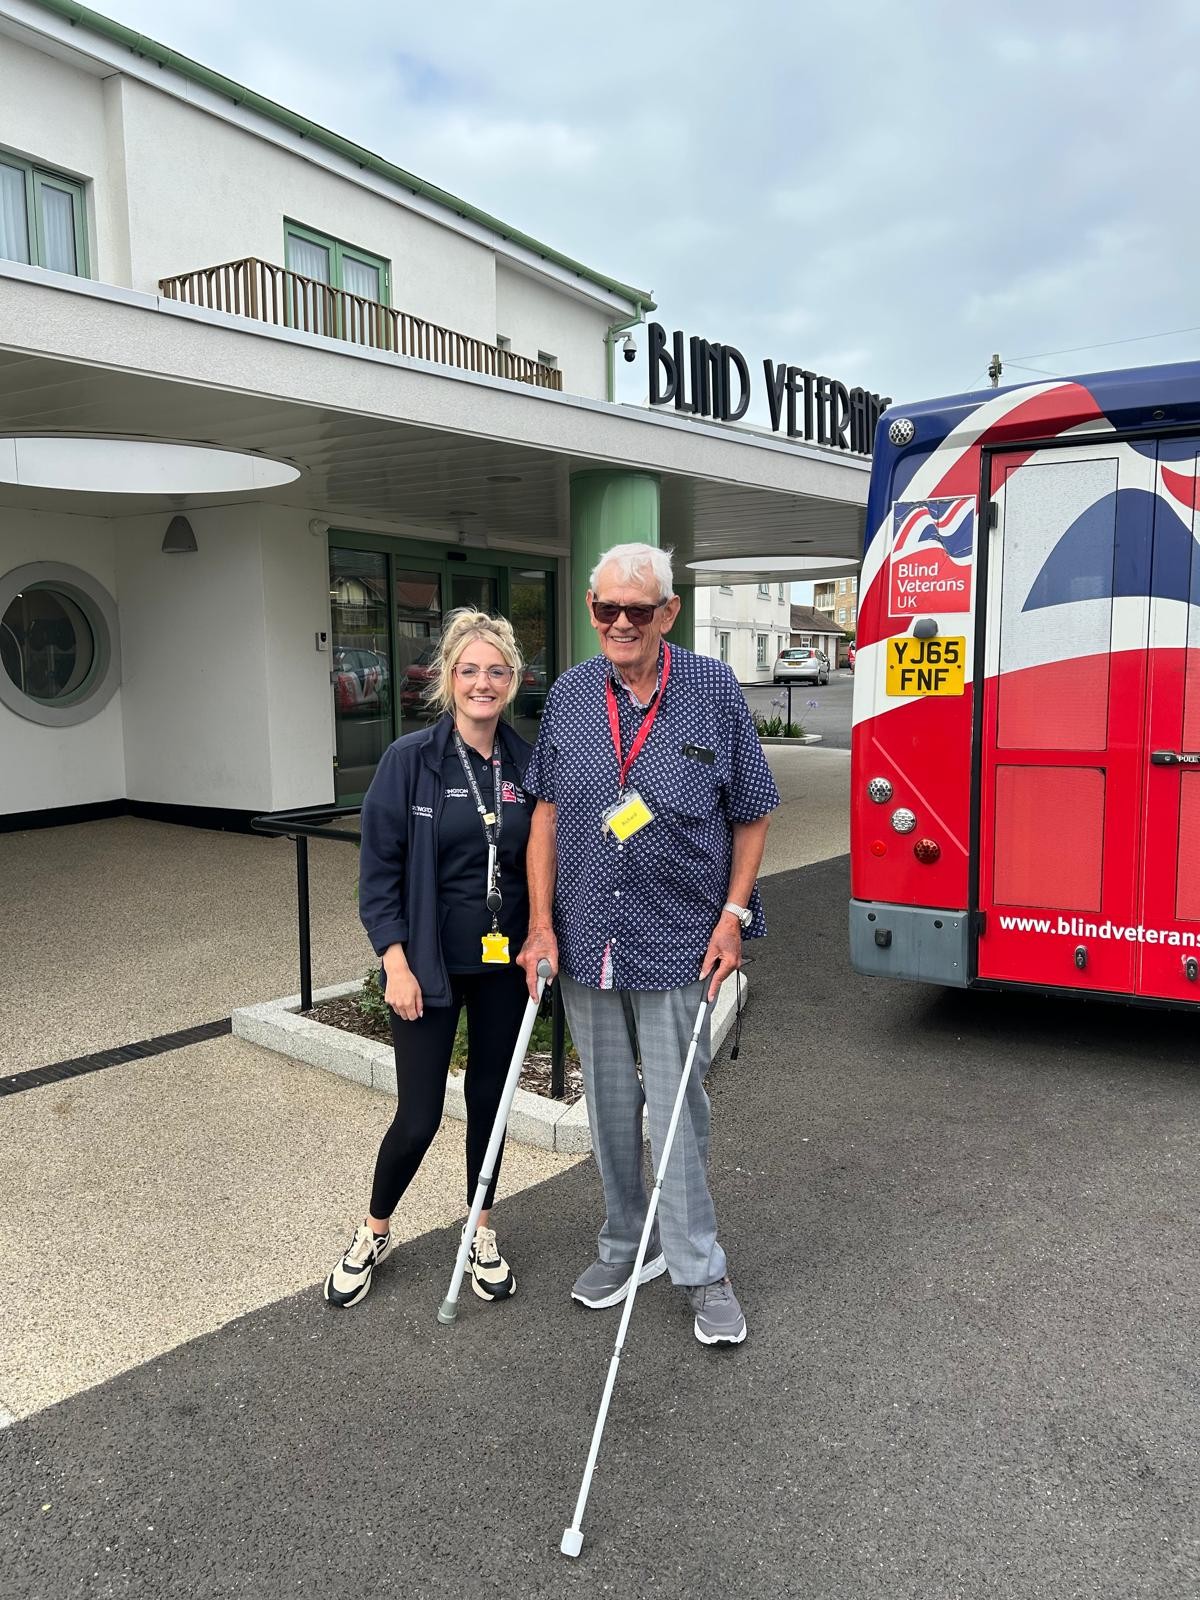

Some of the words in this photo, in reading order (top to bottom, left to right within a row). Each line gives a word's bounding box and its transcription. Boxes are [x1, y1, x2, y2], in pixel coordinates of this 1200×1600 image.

[648, 322, 750, 422] BLIND
[897, 562, 939, 577] Blind
[897, 578, 965, 593] Veterans
[897, 595, 917, 609] UK
[894, 640, 959, 665] YJ65
[900, 668, 949, 691] FNF
